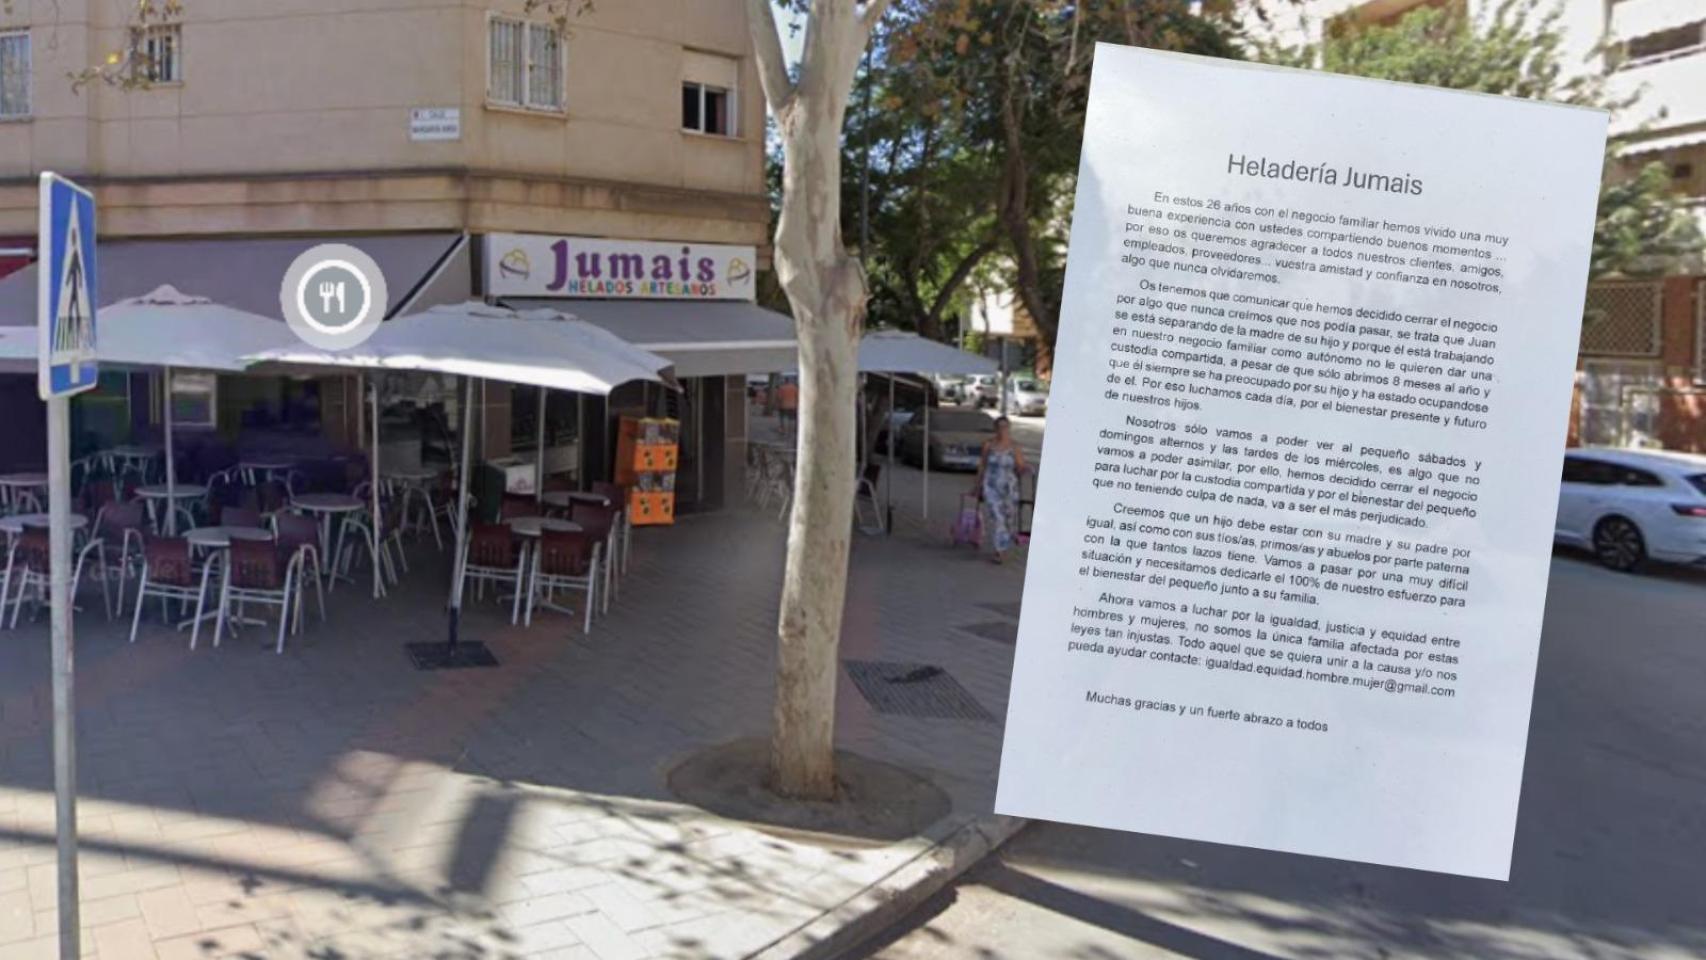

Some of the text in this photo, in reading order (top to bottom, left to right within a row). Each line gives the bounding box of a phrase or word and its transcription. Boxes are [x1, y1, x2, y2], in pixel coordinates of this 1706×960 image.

[1227, 153, 1423, 195] Heladería Jumais
[1127, 203, 1492, 259] buena experiencia ustedes compartiendo buenos momentos
[1172, 196, 1456, 239] estos negocio familiar hemos vivido
[546, 239, 715, 291] Jumais
[1120, 253, 1145, 267] algo
[1173, 261, 1208, 274] nunca
[1191, 231, 1247, 246] queremos
[1249, 239, 1307, 253] agradecer
[1322, 246, 1353, 259] todos
[1356, 252, 1405, 265] nuestros
[1275, 258, 1316, 271] vuestra
[1318, 264, 1363, 277] amistad
[1375, 271, 1430, 285] confianza
[568, 279, 717, 296] HELADOS ARTESANOS
[1158, 282, 1498, 333] tenemos comunicar hemos decidido cerrar negocio
[1138, 296, 1163, 310] algo
[1190, 304, 1225, 317] nunca
[1414, 330, 1440, 343] trata
[1467, 336, 1496, 348] Juan
[1158, 316, 1494, 365] separando madre hijo porque trabajando
[1110, 342, 1158, 356] custodia
[1240, 359, 1272, 371] pesar
[1343, 370, 1389, 385] abrimos
[1403, 379, 1441, 391] meses
[1131, 329, 1174, 342] nuestro
[1178, 335, 1222, 349] negocio
[1226, 339, 1267, 354] familiar
[1270, 347, 1302, 359] como
[1399, 362, 1443, 375] quieren
[1121, 393, 1170, 406] nuestros
[1144, 363, 1489, 413] siempre preocupado hijo estado ocupandose
[1188, 383, 1487, 430] luchamos cada bienestar presente futuro
[1125, 414, 1176, 431] Nosotros
[1215, 428, 1252, 441] vamos
[1275, 435, 1309, 447] poder
[1096, 445, 1135, 459] vamos
[1150, 452, 1183, 464] poder
[1287, 467, 1325, 482] hemos
[1328, 473, 1376, 488] decidido
[1380, 481, 1413, 493] cerrar
[1432, 488, 1478, 502] negocio
[1098, 428, 1154, 445] domingos
[1159, 436, 1204, 451] alternos
[1243, 446, 1278, 460] tardes
[1407, 467, 1432, 481] algo
[1094, 462, 1120, 473] para
[1122, 463, 1158, 477] luchar
[1194, 474, 1241, 488] custodia
[1243, 480, 1305, 496] compartida
[1351, 493, 1404, 508] bienestar
[1134, 481, 1183, 497] teniendo
[1185, 489, 1216, 502] culpa
[1113, 502, 1448, 555] Creemos hijo debe estar madre padre
[1138, 524, 1470, 575] como primos/as abuelos parte paterna
[1092, 566, 1146, 582] bienestar
[1219, 582, 1249, 596] junto
[1152, 541, 1352, 575] tantos lazos Vamos pasar
[1145, 558, 1217, 575] necesitamos
[1219, 566, 1271, 582] dedicarle
[1289, 574, 1320, 589] 100%
[1341, 583, 1384, 597] nuestro
[1386, 589, 1437, 604] esfuerzo
[1439, 596, 1466, 607] para
[1072, 605, 1123, 622] hombres
[1213, 625, 1251, 638] somos
[1307, 635, 1344, 650] familia
[1349, 641, 1399, 657] afectada
[1427, 653, 1459, 665] estas
[1098, 592, 1134, 606] Ahora
[1138, 599, 1176, 611] vamos
[1192, 603, 1228, 618] luchar
[1325, 620, 1365, 636] justicia
[1380, 630, 1427, 644] equidad
[1430, 635, 1461, 648] entre
[1067, 641, 1104, 653] pueda
[1106, 645, 1147, 658] ayudar
[1070, 622, 1101, 636] leyes
[1177, 635, 1206, 649] Todo
[1209, 641, 1240, 653] aquel
[1286, 651, 1322, 664] quiera
[1326, 656, 1348, 667] unir
[1377, 663, 1411, 675] causa
[1085, 690, 1328, 732] Muchas gracias fuerte abrazo todos
